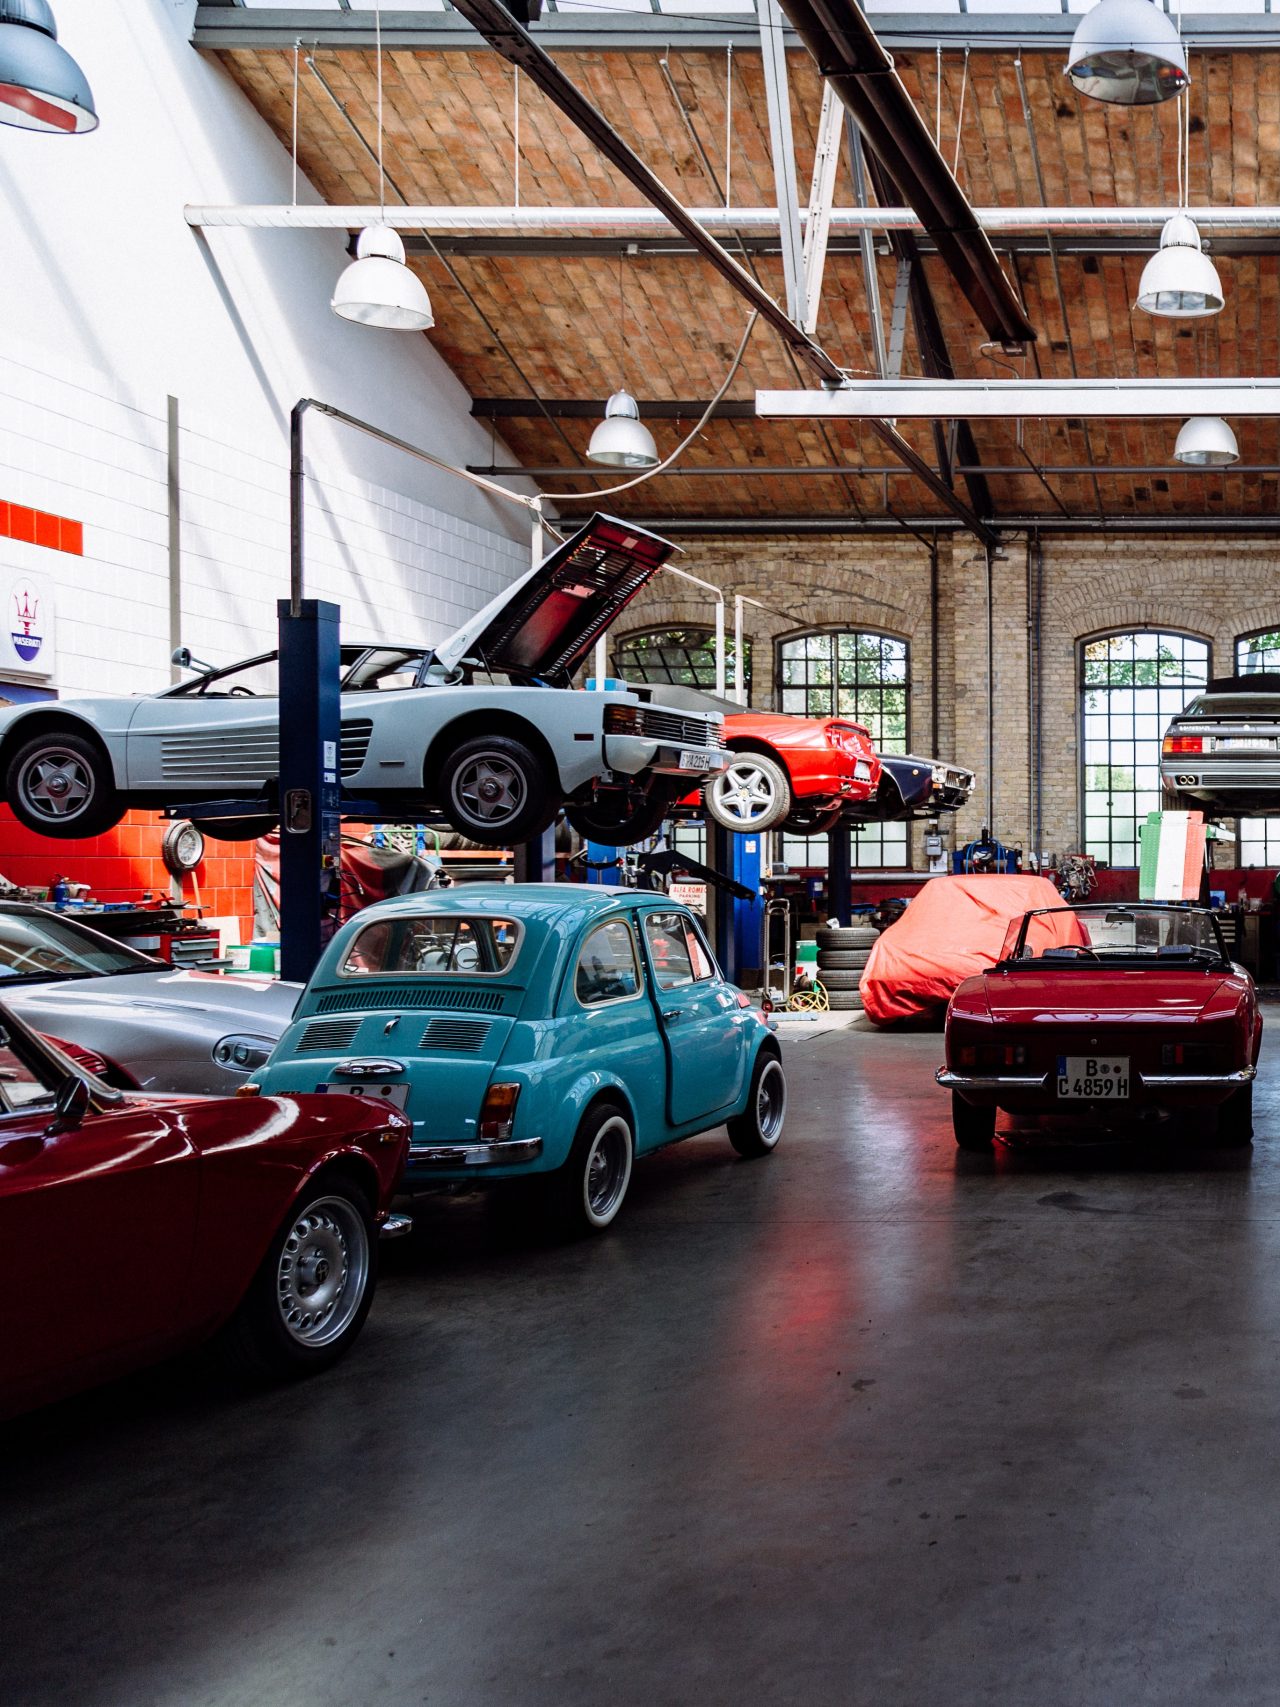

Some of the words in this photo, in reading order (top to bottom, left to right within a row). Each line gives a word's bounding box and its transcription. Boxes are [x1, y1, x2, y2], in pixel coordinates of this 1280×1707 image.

[1086, 1059, 1098, 1076] B
[1059, 1079, 1069, 1096] C
[1073, 1079, 1114, 1097] 4859
[1117, 1079, 1128, 1097] H
